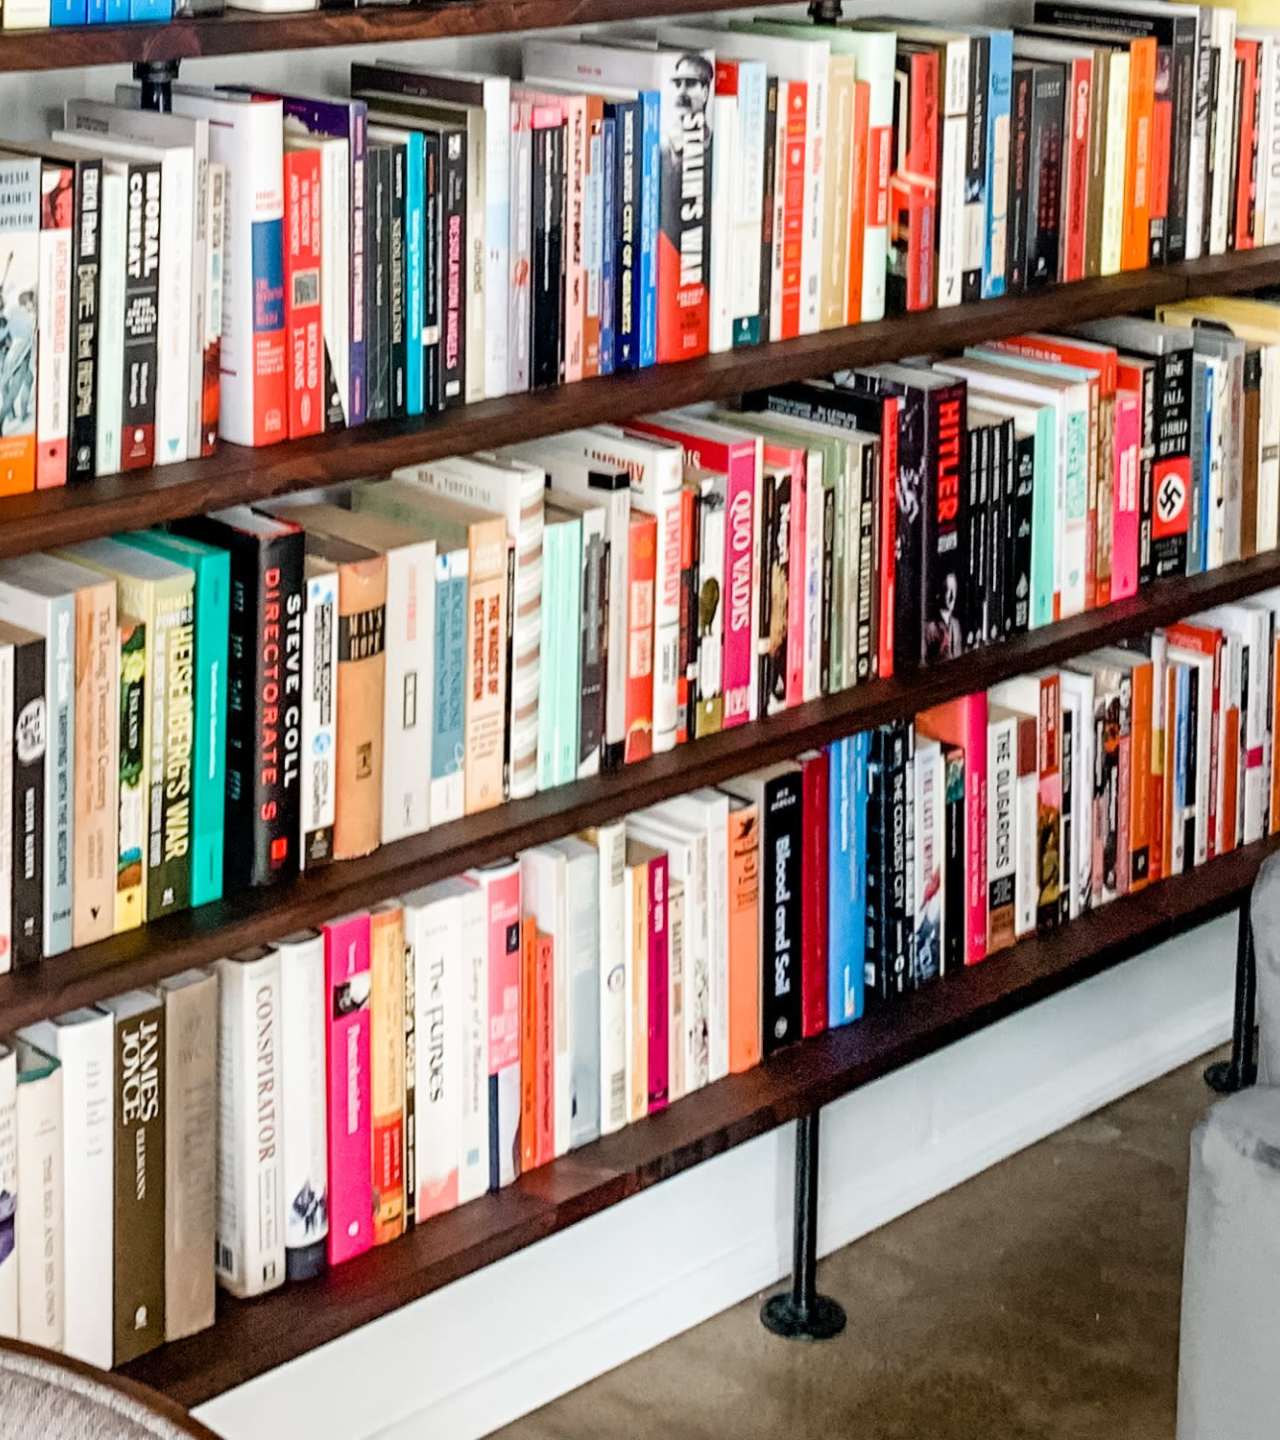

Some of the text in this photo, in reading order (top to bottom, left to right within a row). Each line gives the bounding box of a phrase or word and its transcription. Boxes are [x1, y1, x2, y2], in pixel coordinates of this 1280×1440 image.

[128, 172, 143, 279] COMBAT
[144, 171, 160, 278] MORAL
[679, 111, 704, 288] STALIN'S WAR
[306, 323, 319, 389] RICHARD
[936, 398, 961, 524] HITLER
[1159, 420, 1189, 440] THIRD
[1159, 436, 1188, 457] REICH
[664, 504, 681, 608] LIMONOV
[729, 489, 753, 634] QUO VADIS
[261, 567, 281, 822] DIRECTORATE S
[283, 593, 301, 788] STEVE COLL
[472, 598, 485, 702] DESTRUCTION
[487, 594, 501, 695] THE WAGES OF
[93, 606, 111, 812] The Long Twentieth Century
[164, 624, 193, 862] HEISENBERG'S WAR
[892, 772, 906, 909] THE COLDEST CITY
[994, 729, 1013, 868] THE OLIGARCHS
[772, 834, 791, 998] Blood and Soil
[121, 1029, 141, 1125] JOYCE
[138, 1020, 160, 1121] JAMES
[255, 984, 277, 1164] CONSPIRATOR
